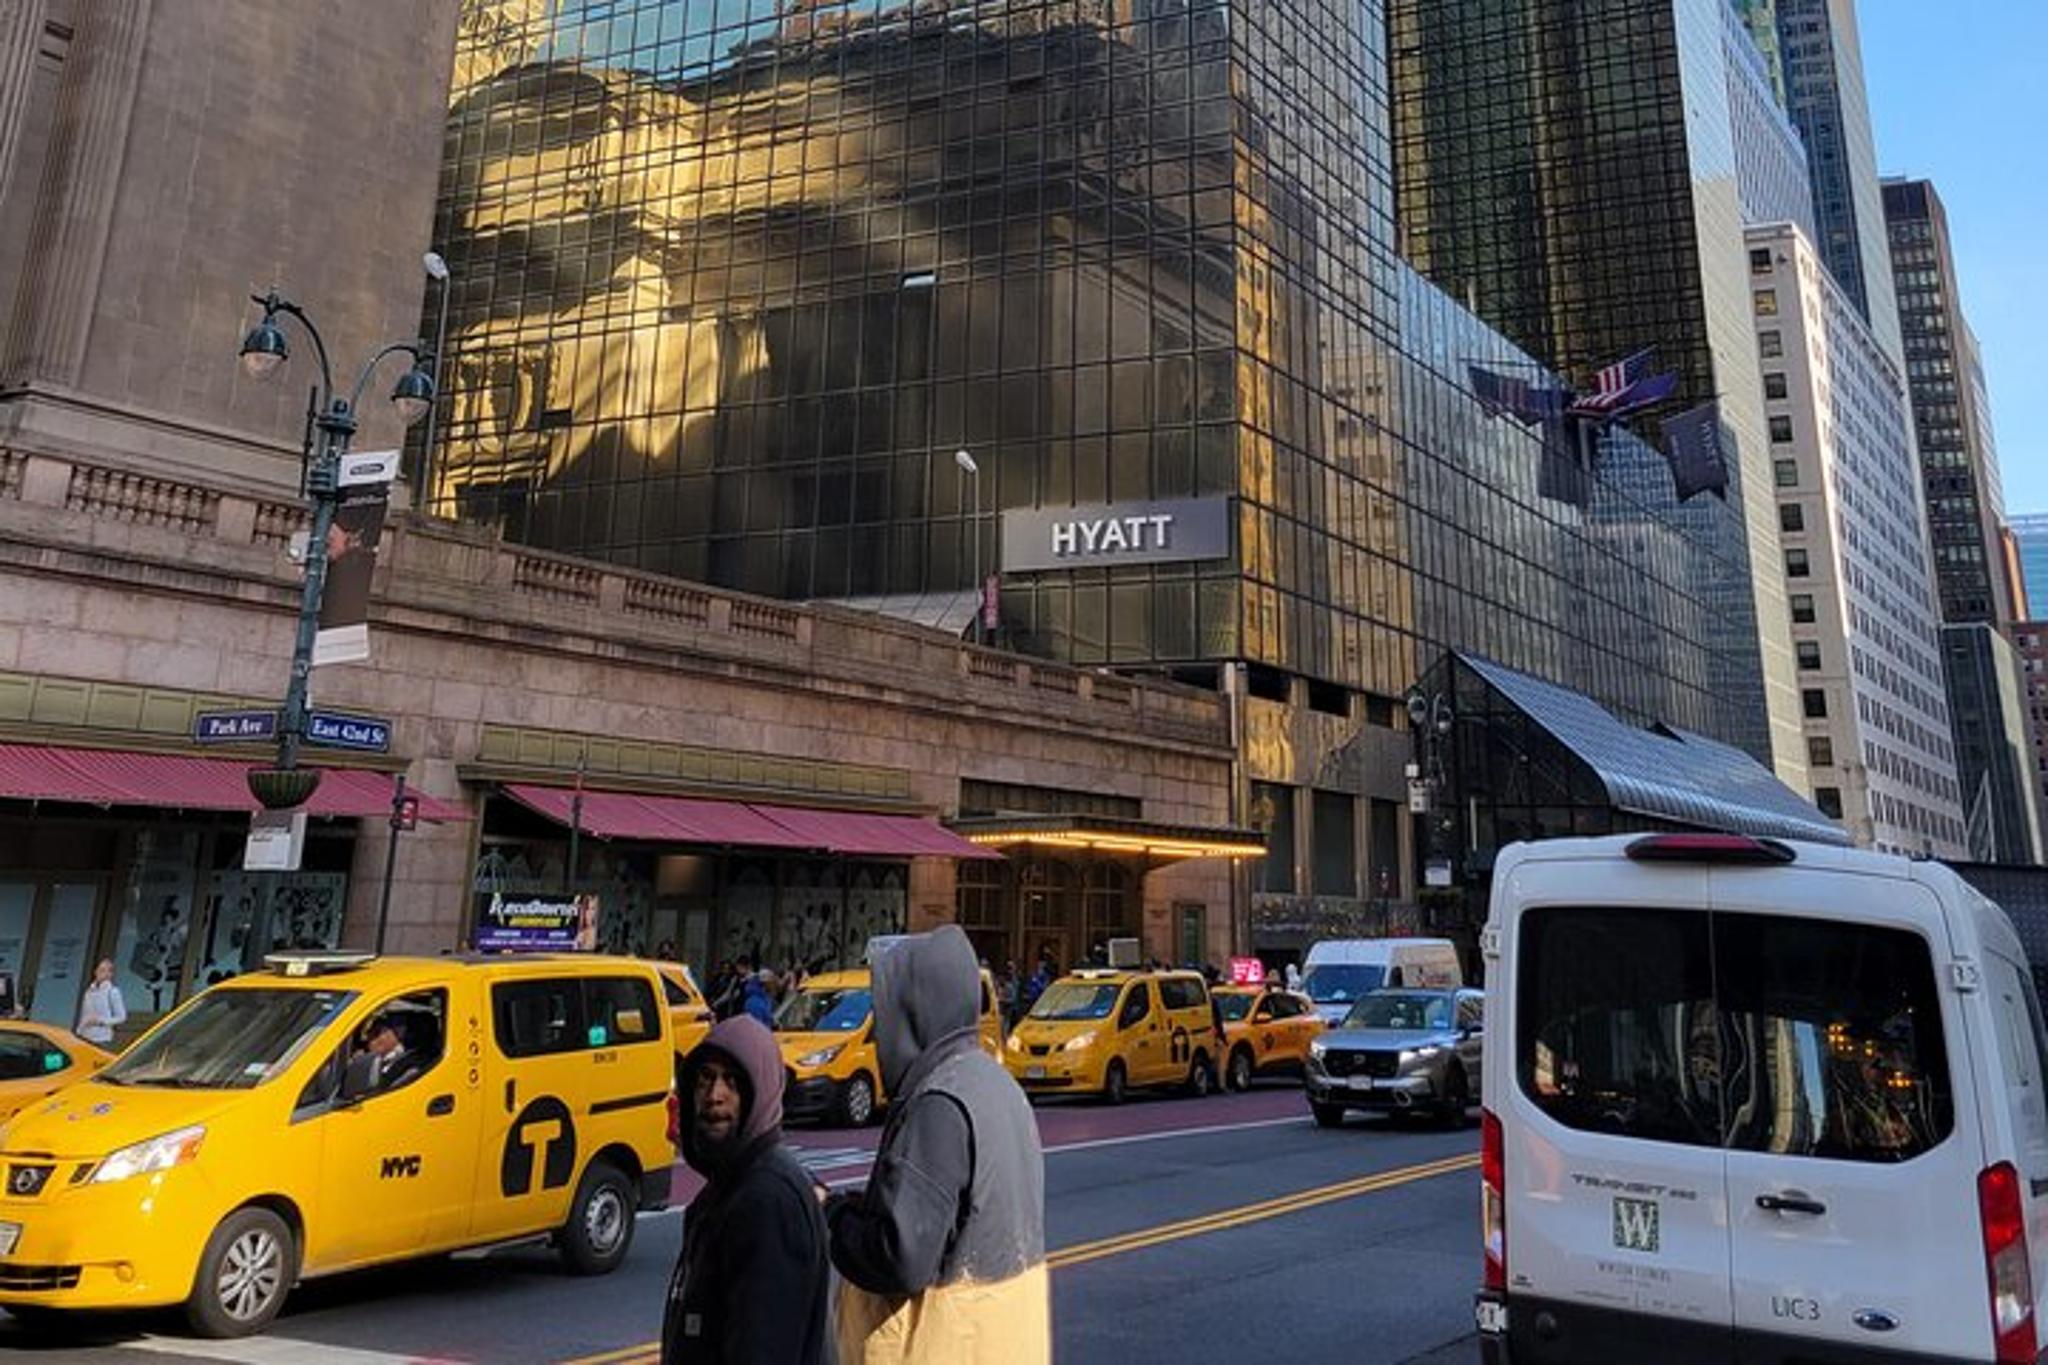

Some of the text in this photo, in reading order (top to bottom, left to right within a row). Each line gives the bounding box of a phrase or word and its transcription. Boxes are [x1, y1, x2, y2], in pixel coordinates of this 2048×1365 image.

[1052, 514, 1173, 553] HYATT
[209, 718, 263, 735] Park Ave
[312, 718, 385, 744] East 42nd St
[381, 1154, 421, 1180] NYC
[1616, 1200, 1657, 1248] W
[1808, 1299, 1821, 1321] 3
